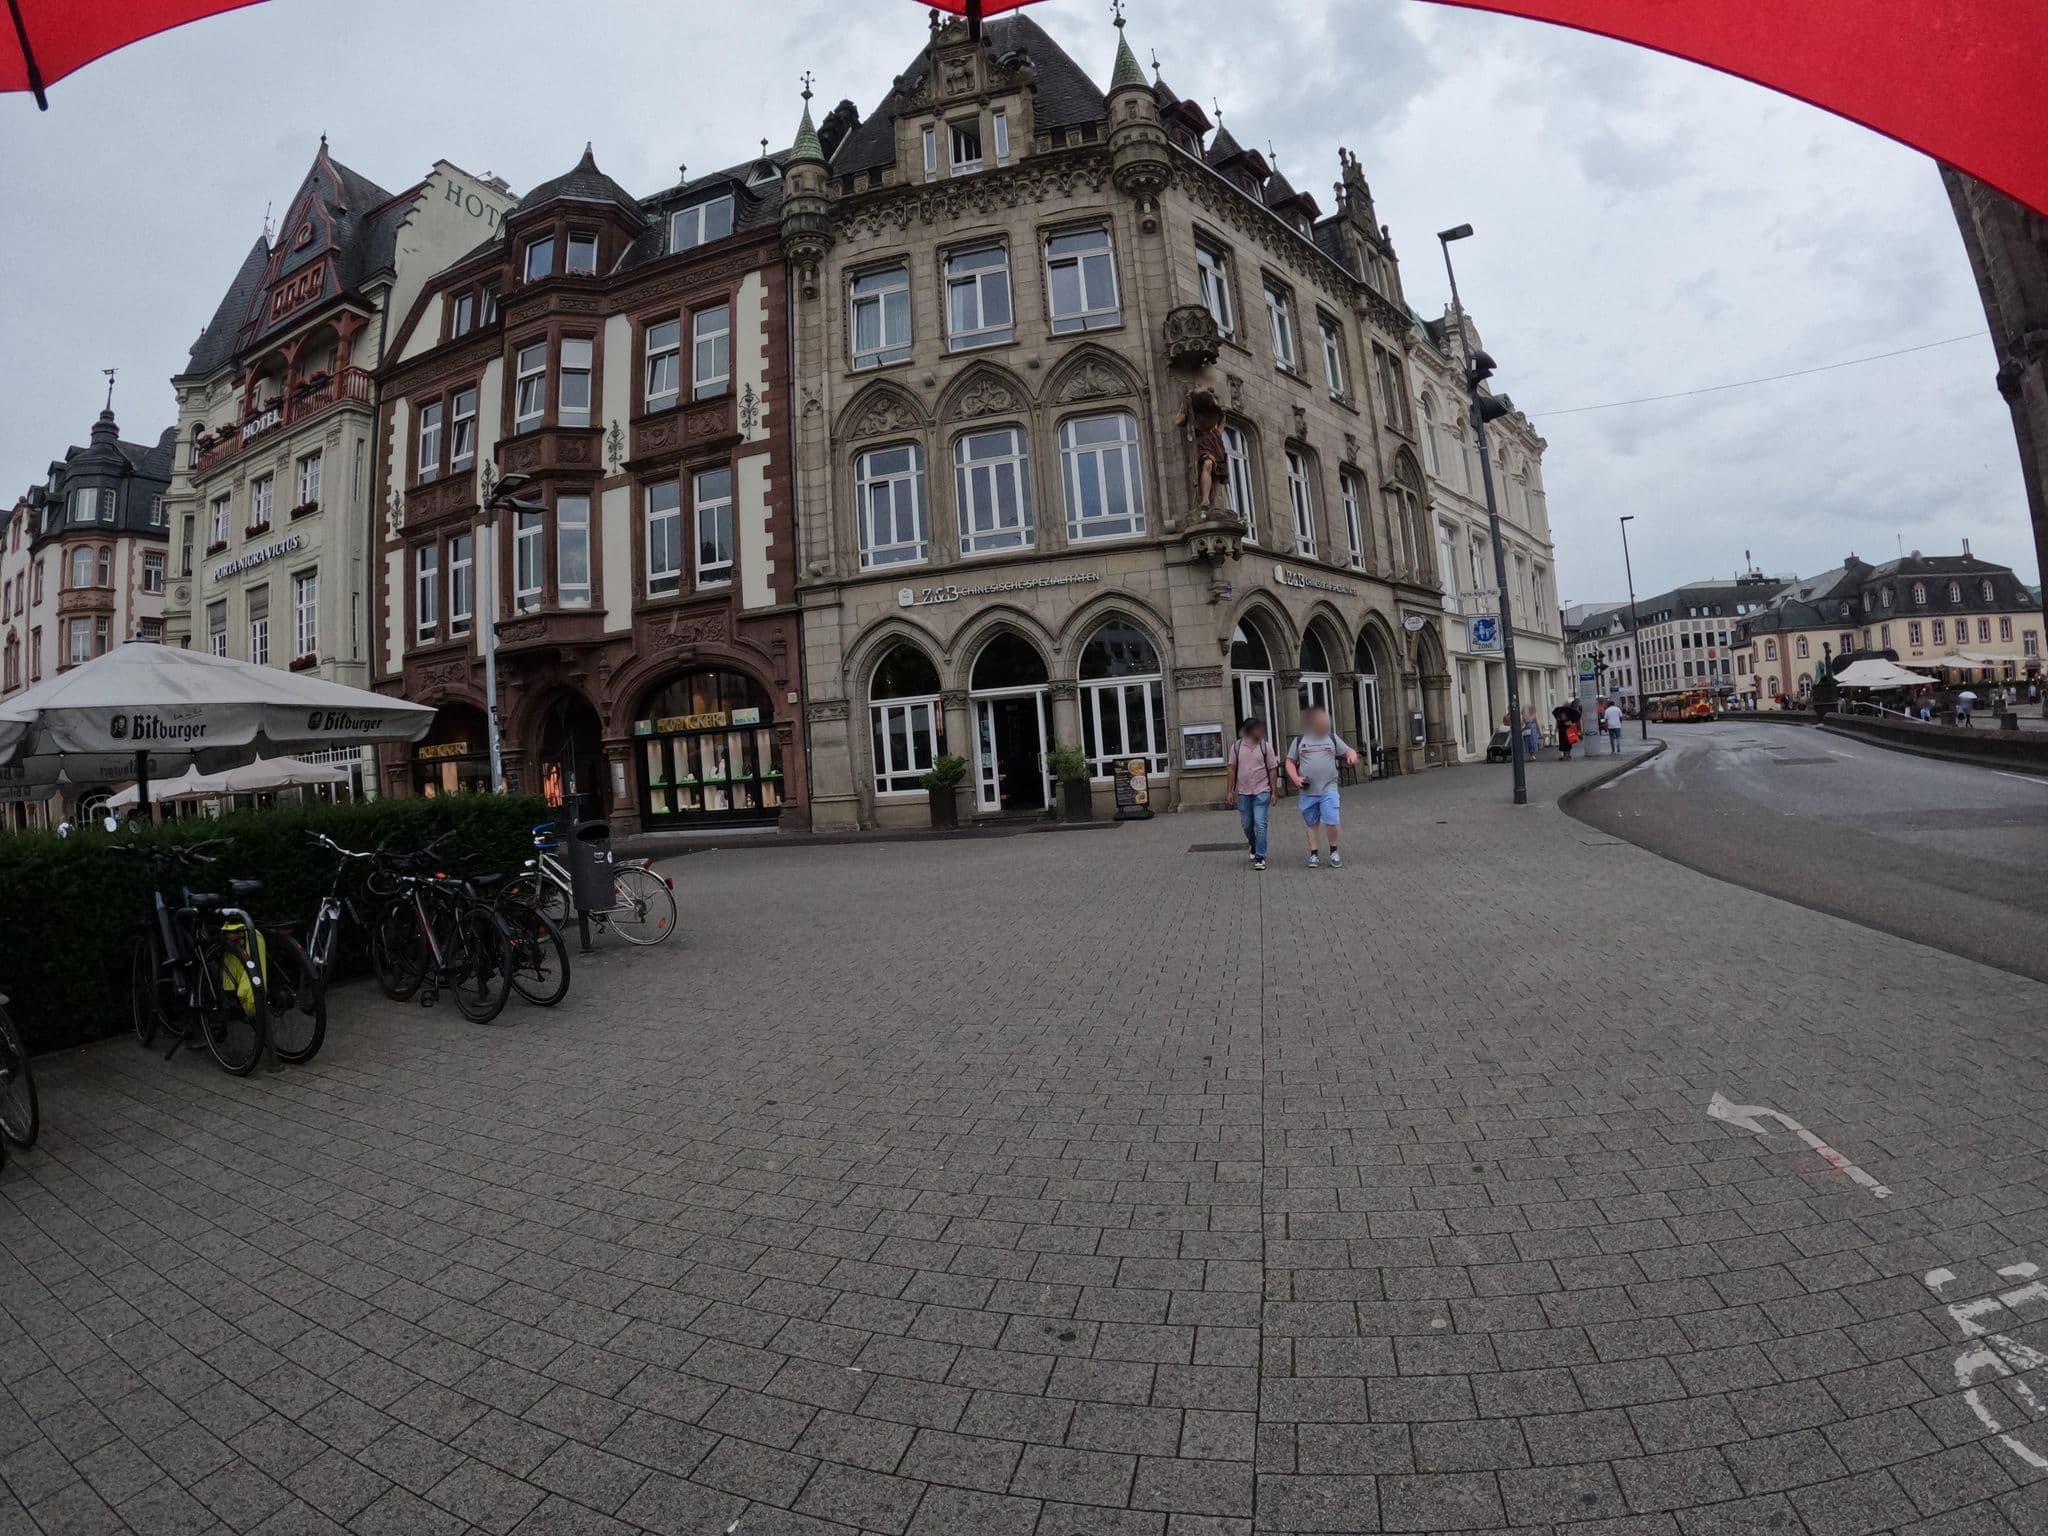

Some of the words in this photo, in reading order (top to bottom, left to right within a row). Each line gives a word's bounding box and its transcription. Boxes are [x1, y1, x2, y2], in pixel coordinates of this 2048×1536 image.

[242, 409, 279, 440] HOTEL
[213, 559, 241, 580] PORTA
[239, 549, 268, 571] NIGRA
[266, 535, 300, 558] VICTUS
[921, 585, 960, 604] Z&B
[961, 581, 1024, 596] CHINESISCHE
[131, 714, 207, 742] Bitburger
[323, 711, 384, 733] Bitburger
